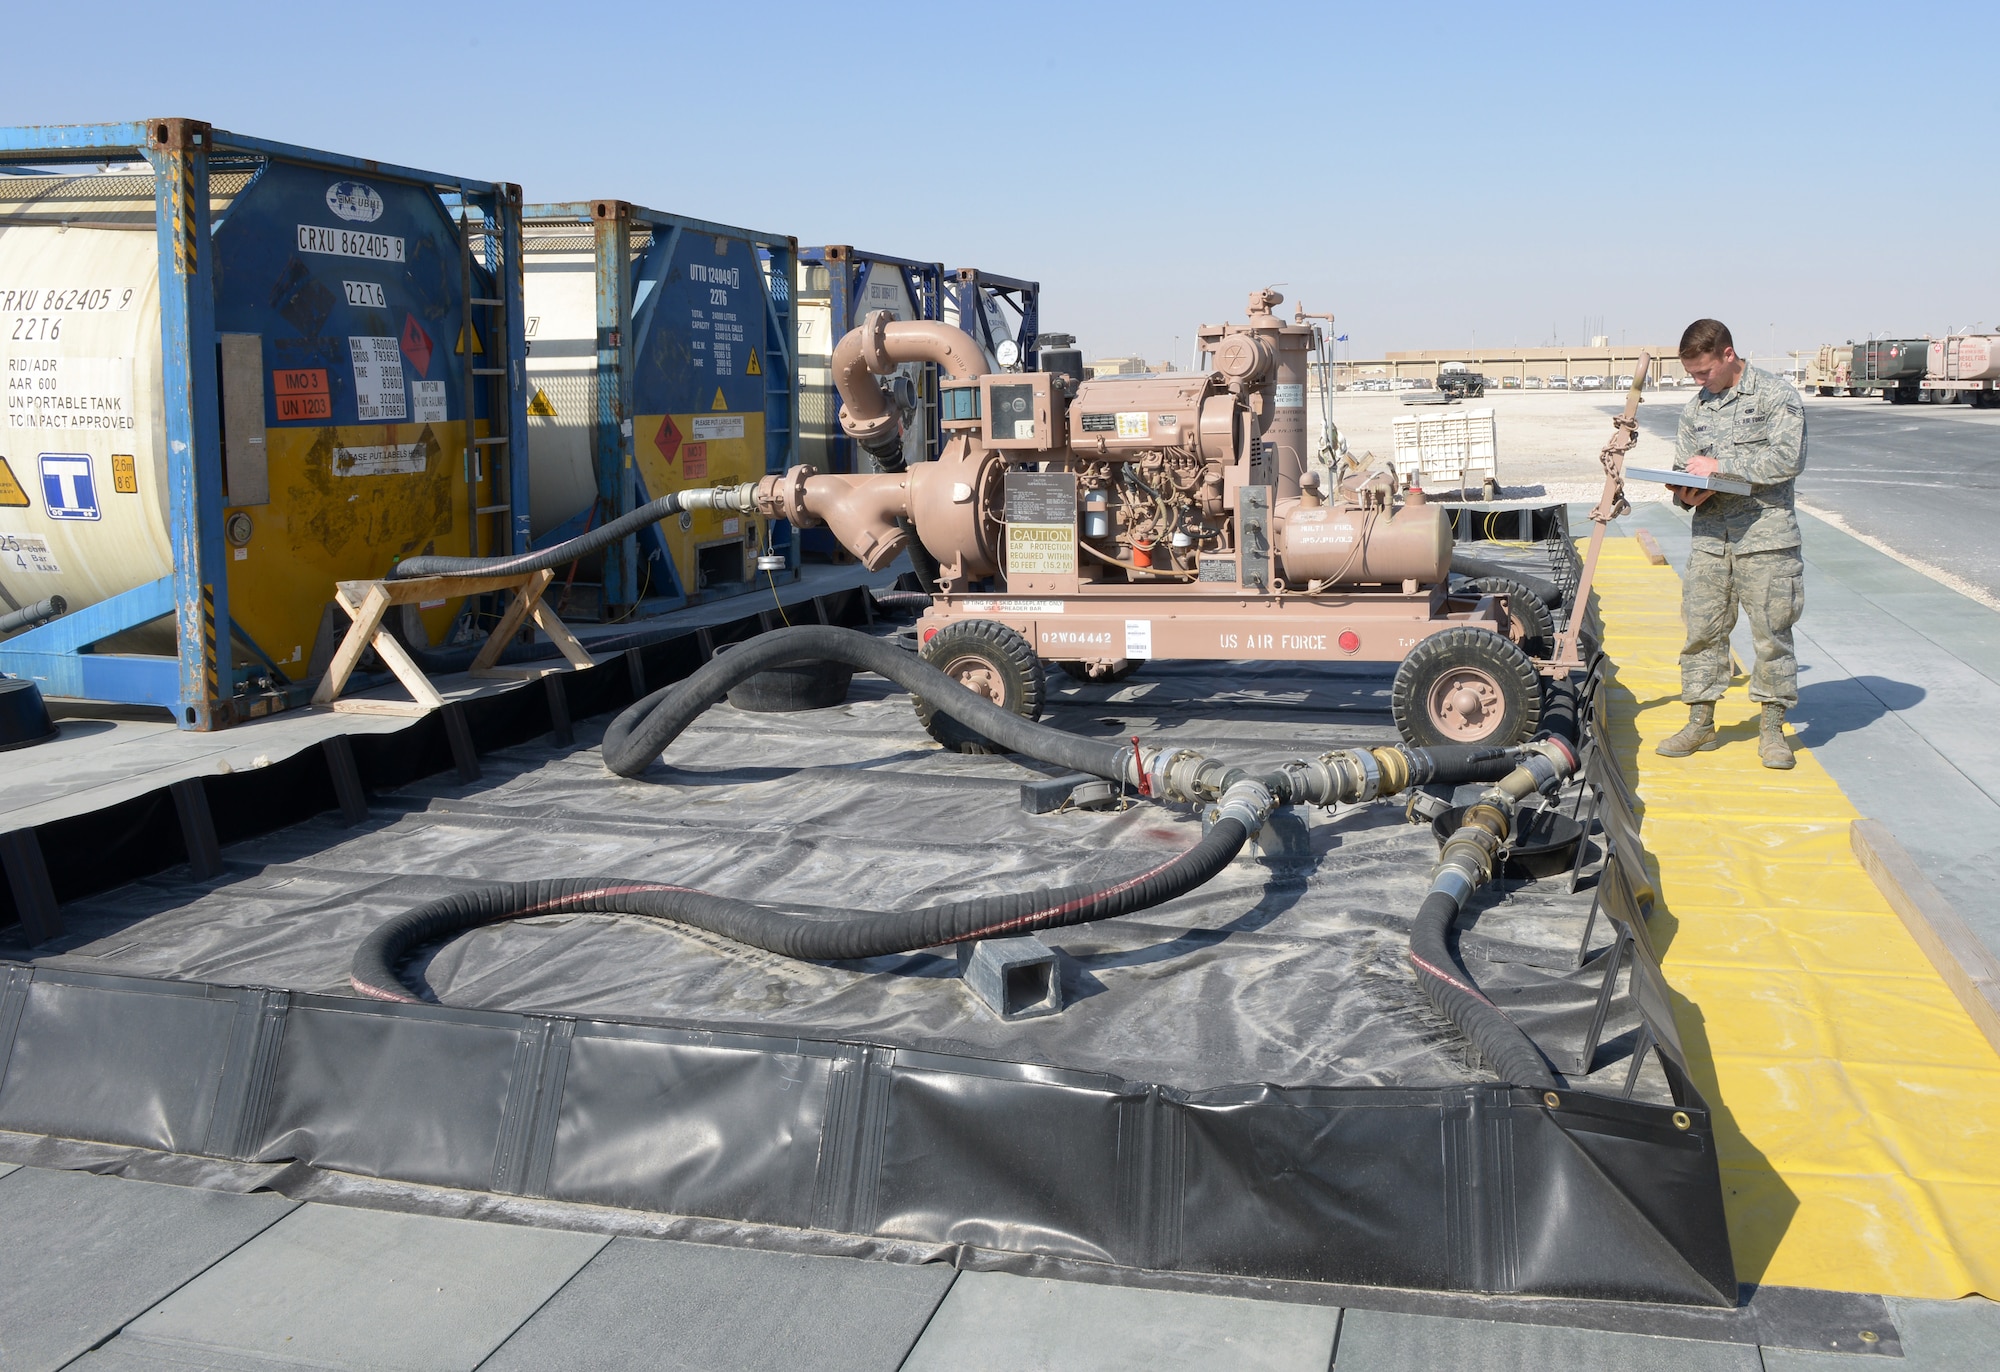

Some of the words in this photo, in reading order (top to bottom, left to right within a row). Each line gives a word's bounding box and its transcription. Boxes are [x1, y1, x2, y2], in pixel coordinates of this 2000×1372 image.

[300, 227, 334, 252] CRXU
[342, 232, 388, 258] 862405
[396, 240, 402, 259] 9
[690, 264, 706, 282] UTTU
[708, 266, 731, 286] 124049
[43, 289, 112, 310] 862405
[120, 288, 133, 309] 9
[346, 283, 384, 306] 22T6
[710, 288, 727, 306] 22T6
[12, 318, 62, 340] 22T6
[692, 320, 710, 329] CAPACITY
[350, 339, 362, 350] MAX
[353, 352, 369, 362] GROSS
[9, 359, 57, 371] RID/ADR
[355, 367, 368, 378] TARE
[9, 378, 32, 390] AAR
[39, 378, 57, 390] 600
[285, 374, 308, 389] IMO
[312, 373, 318, 388] 3
[9, 396, 24, 408] UN
[27, 396, 87, 409] PORTABLE
[90, 397, 121, 410] TANK
[359, 394, 369, 405] MAX
[283, 400, 299, 415] UN
[303, 399, 326, 414] 1203
[360, 406, 379, 418] PAYLOAD
[10, 415, 23, 426] TC
[71, 416, 134, 429] APPROVED
[370, 452, 382, 460] PUT
[384, 450, 407, 459] LABELS
[1014, 530, 1068, 541] CAUTION
[1010, 552, 1044, 560] REQUIRED
[1043, 561, 1060, 569] (15.2
[1042, 632, 1112, 643] 02W04442
[1220, 634, 1237, 649] US
[1247, 634, 1273, 649] AIR
[1282, 635, 1326, 650] FORCE
